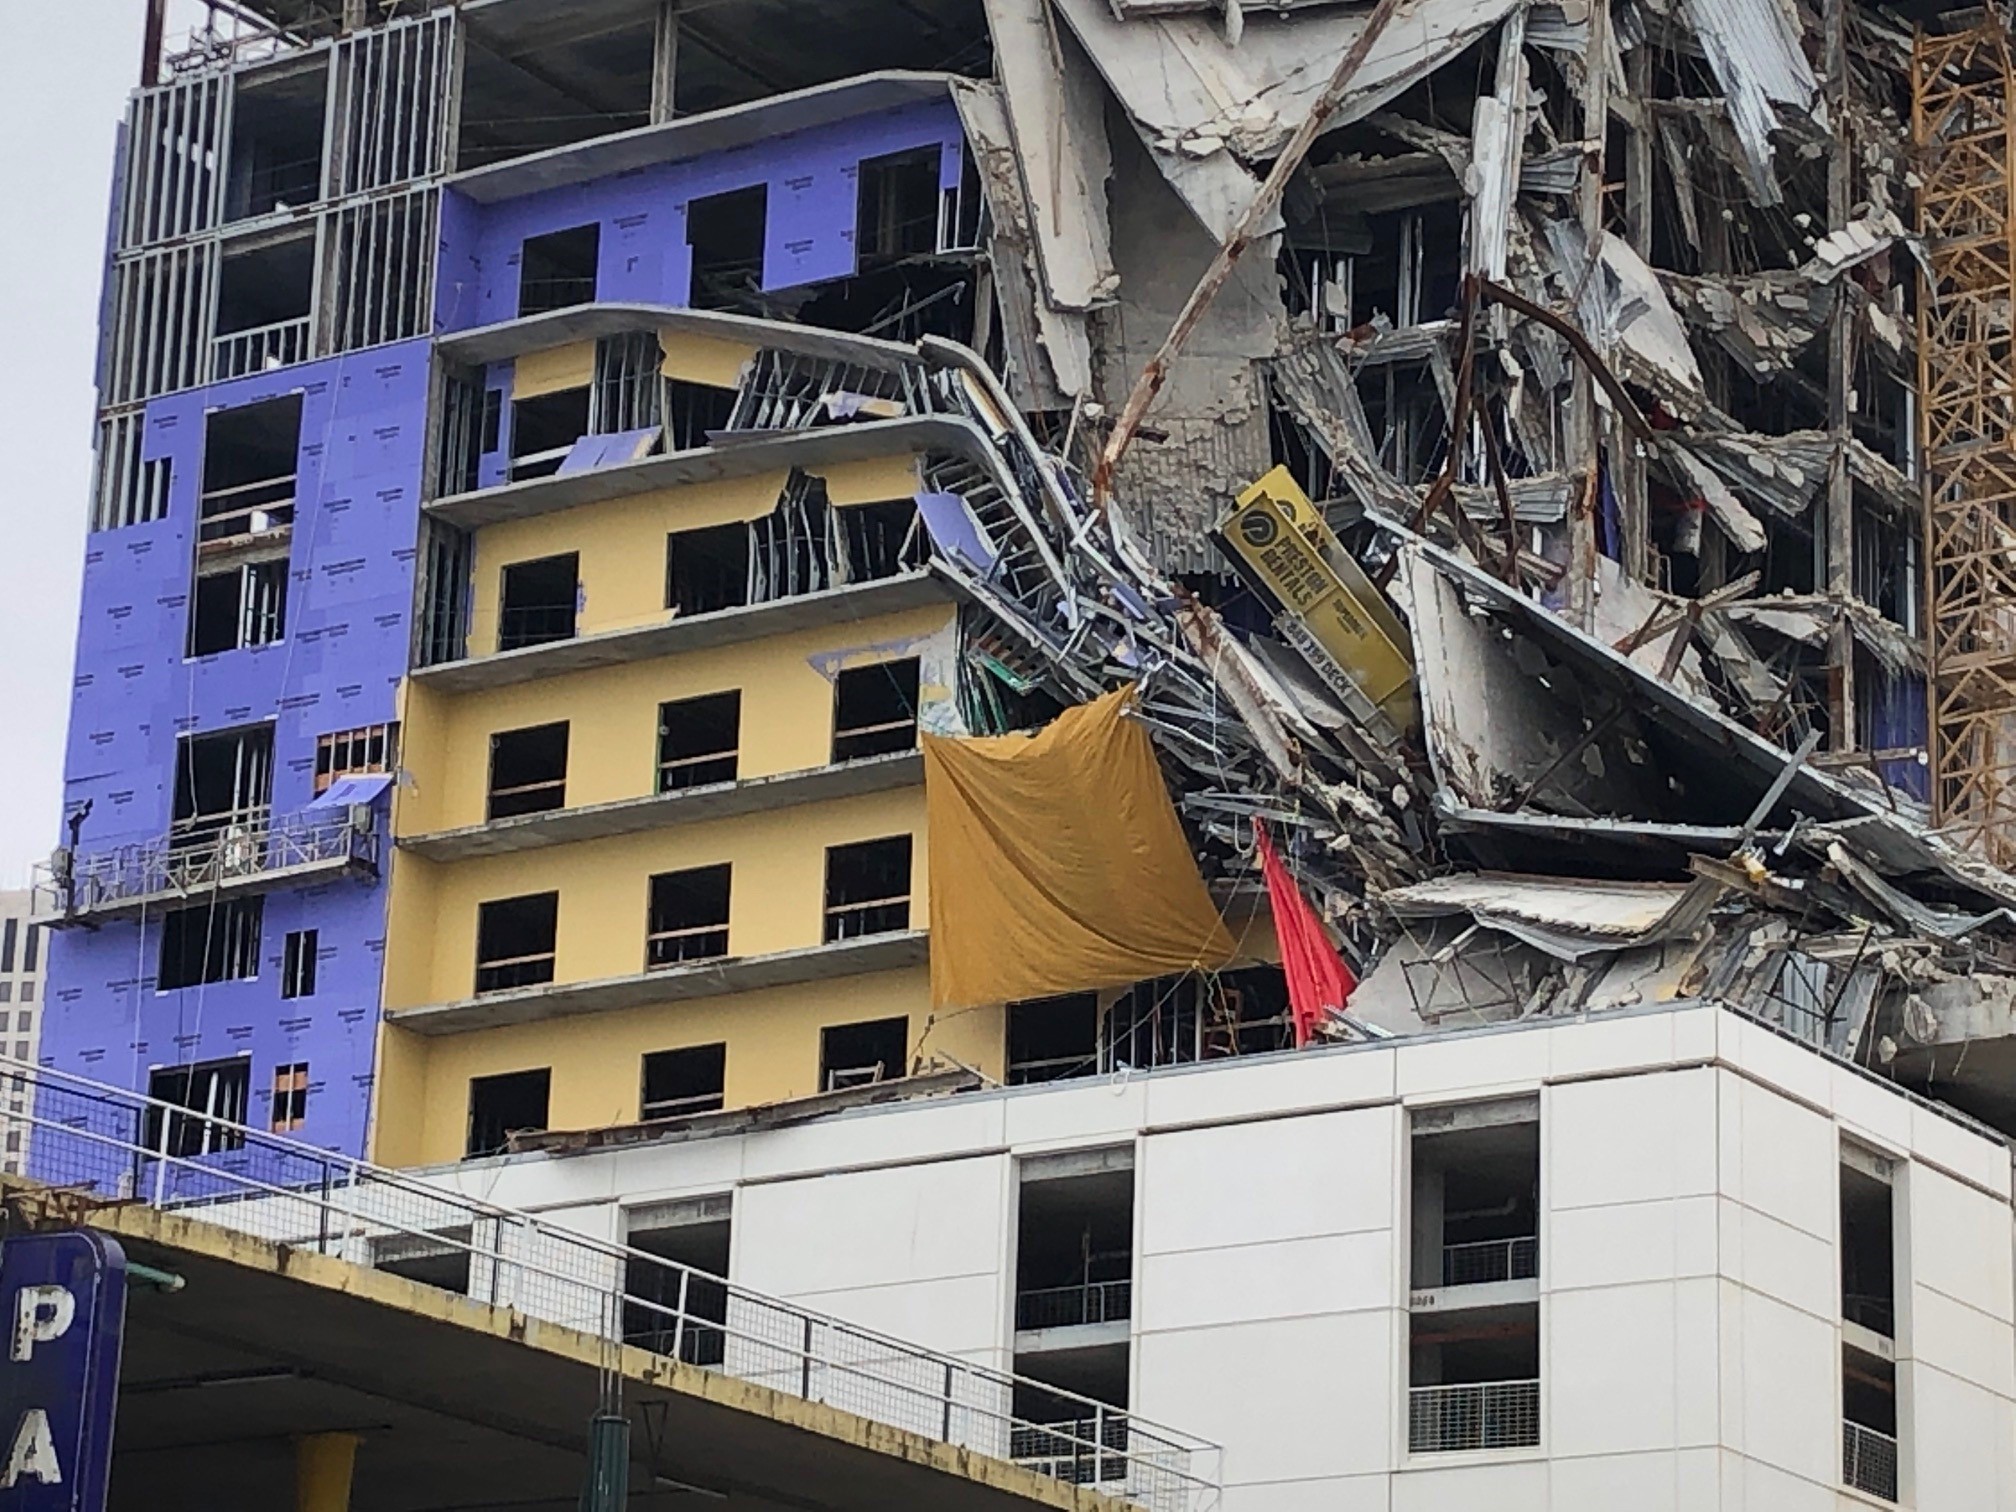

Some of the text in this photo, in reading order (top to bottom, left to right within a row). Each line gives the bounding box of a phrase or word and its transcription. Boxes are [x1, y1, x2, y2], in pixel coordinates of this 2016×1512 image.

[1259, 549, 1313, 606] RENTALS
[1274, 536, 1329, 595] PRESTON
[1321, 661, 1354, 693] DECK
